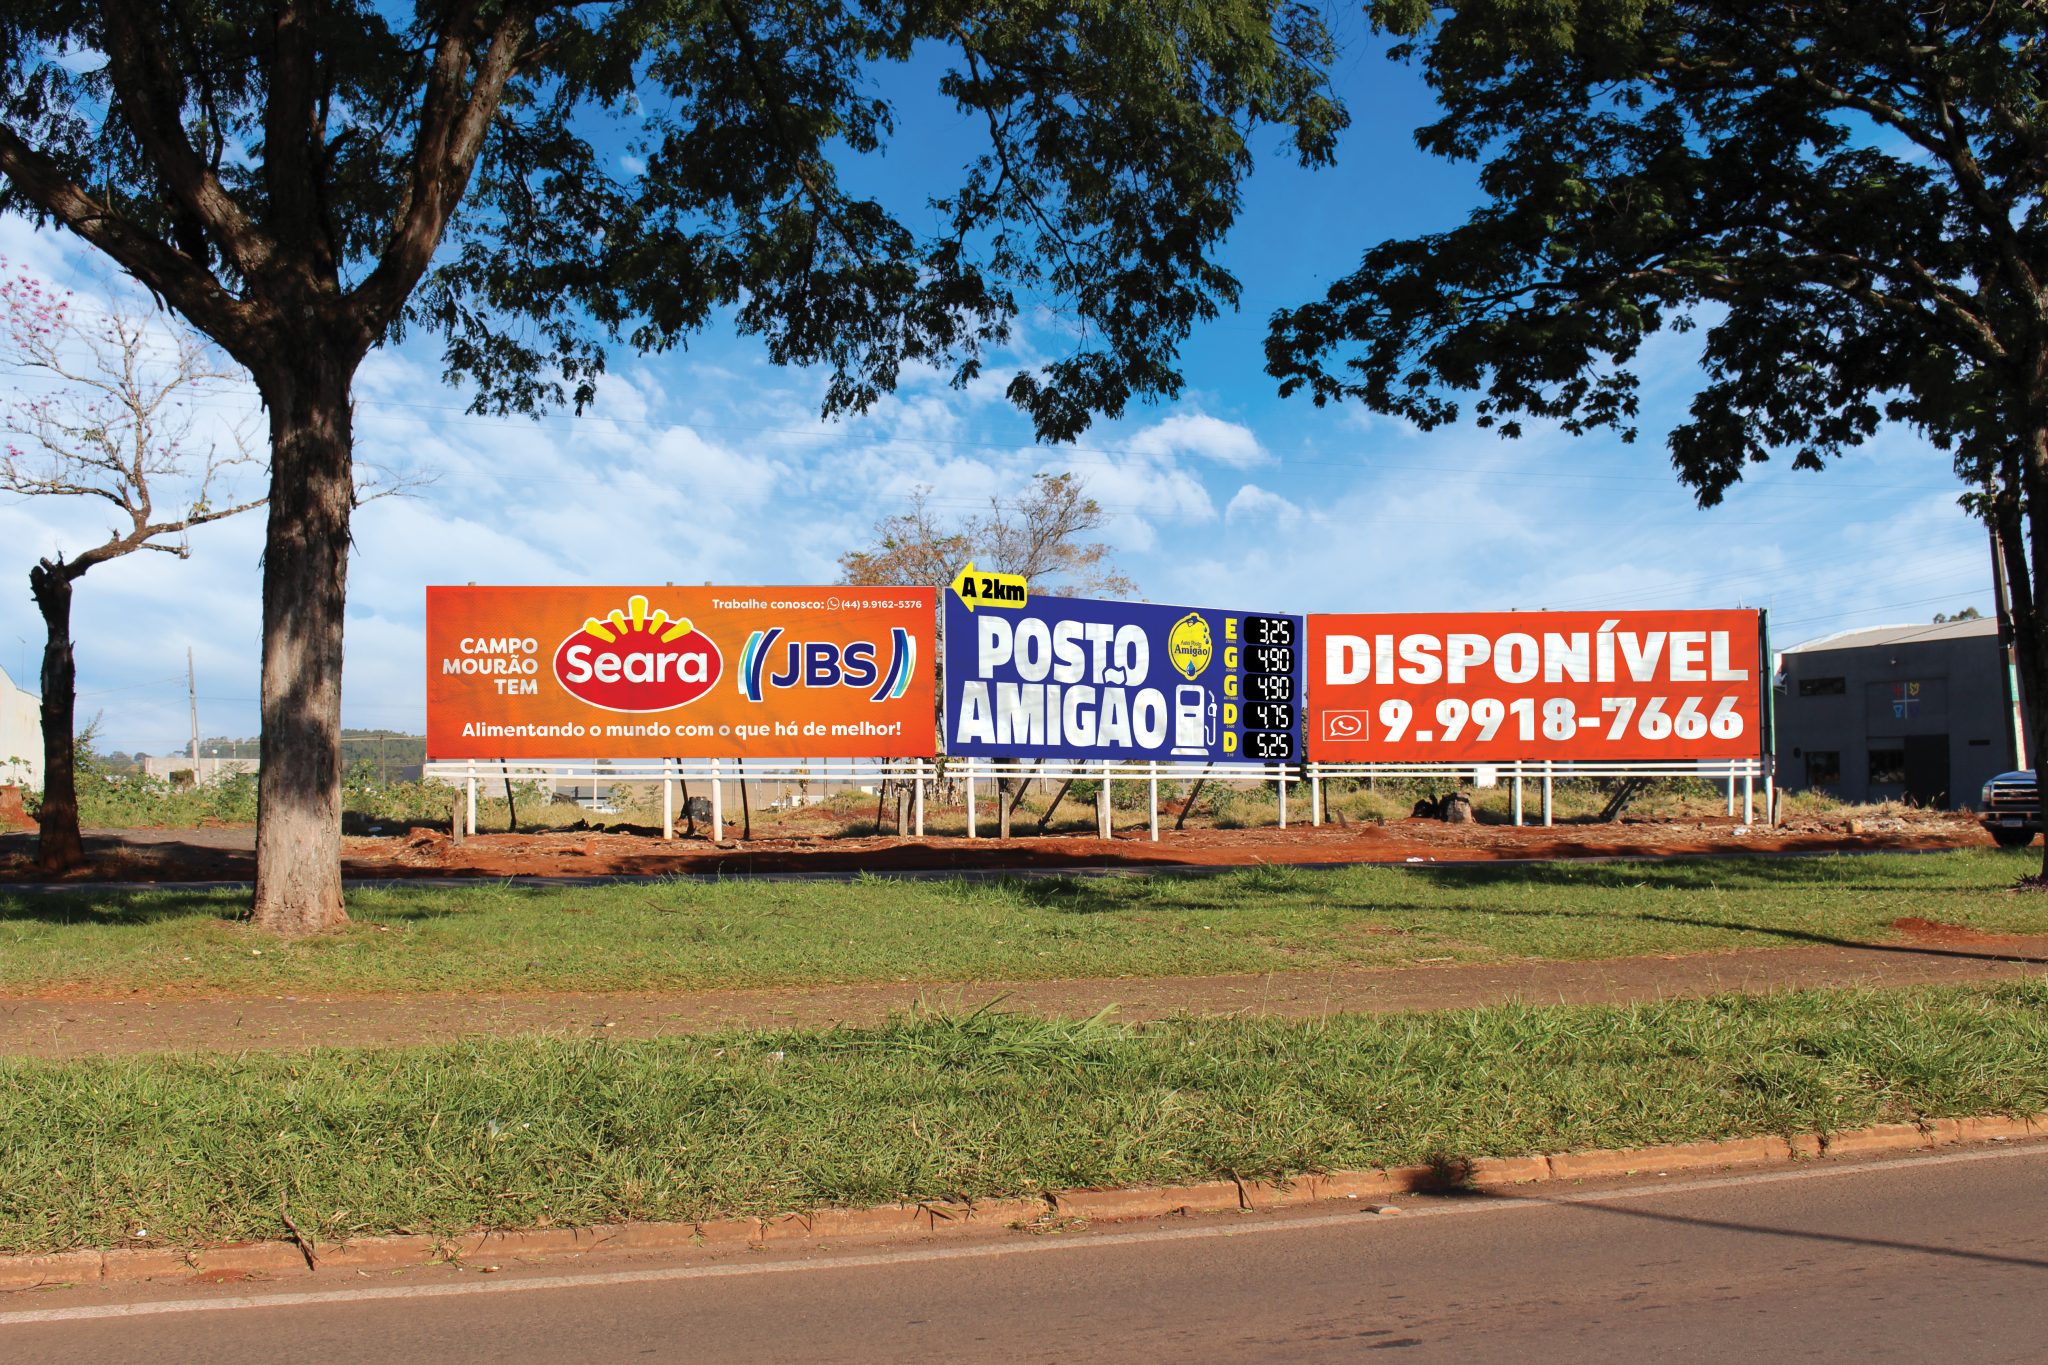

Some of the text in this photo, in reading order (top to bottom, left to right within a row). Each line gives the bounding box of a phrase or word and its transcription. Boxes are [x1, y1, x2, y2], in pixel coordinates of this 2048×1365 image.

[961, 577, 1025, 601] A 2km
[712, 599, 922, 610] Trabalhe conosco: (44) 9.9162-5376
[1225, 617, 1289, 644] E 3,25
[460, 637, 538, 654] CAMPO
[978, 615, 1149, 686] POSTO
[1325, 620, 1748, 685] DISPONÍVEL
[442, 655, 538, 675] MOURÃO
[565, 644, 708, 683] Seara
[771, 642, 878, 688] JBS
[1224, 646, 1289, 672] G 4,90
[494, 678, 538, 695] TEM
[1223, 674, 1289, 700] G 4,90
[956, 668, 1168, 749] AMIGÃO
[1223, 703, 1289, 729] D 4,75
[1379, 696, 1744, 742] 9.9918-7666
[462, 721, 902, 741] Alimentando o mundo com o que há de melhor!
[1223, 731, 1289, 758] D 5,25
